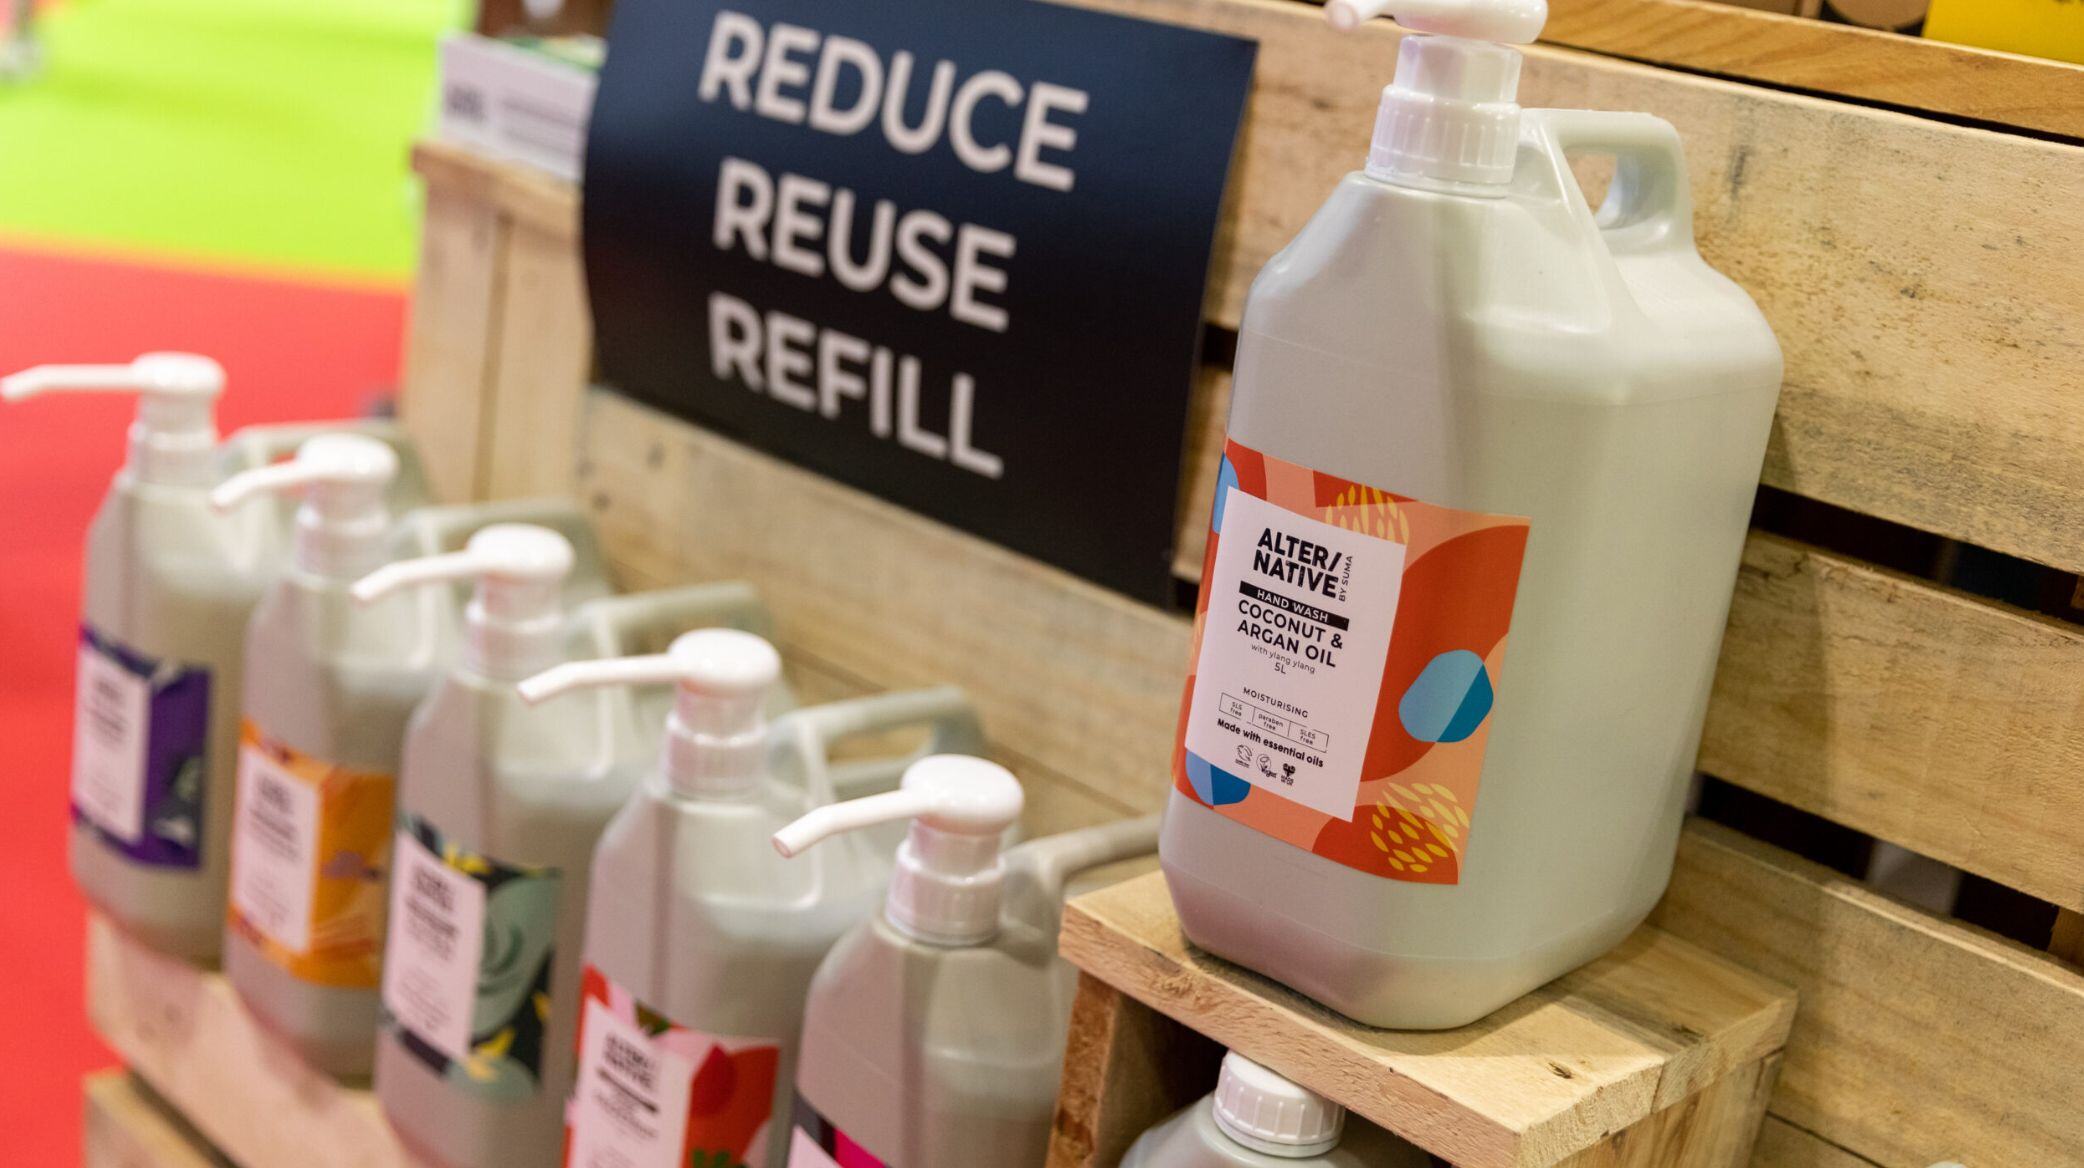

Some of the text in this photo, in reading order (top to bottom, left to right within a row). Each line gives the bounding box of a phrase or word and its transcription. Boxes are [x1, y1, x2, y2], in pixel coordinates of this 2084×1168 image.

[699, 10, 1089, 192] REDUCE
[713, 157, 1017, 332] REUSE
[707, 294, 1003, 480] REFILL
[1253, 549, 1339, 598] NATIVE
[1257, 528, 1342, 572] ALTER/
[1339, 556, 1353, 602] BY SUMA
[1238, 600, 1343, 649] COCONUT &
[1257, 589, 1329, 623] HAND WASH
[1237, 620, 1336, 668] ARGAN OIL
[1251, 644, 1315, 674] with ylang ylang
[1274, 662, 1287, 674] 5L
[1243, 687, 1309, 718] MOISTURISING
[1217, 718, 1323, 768] Made with essential oils
